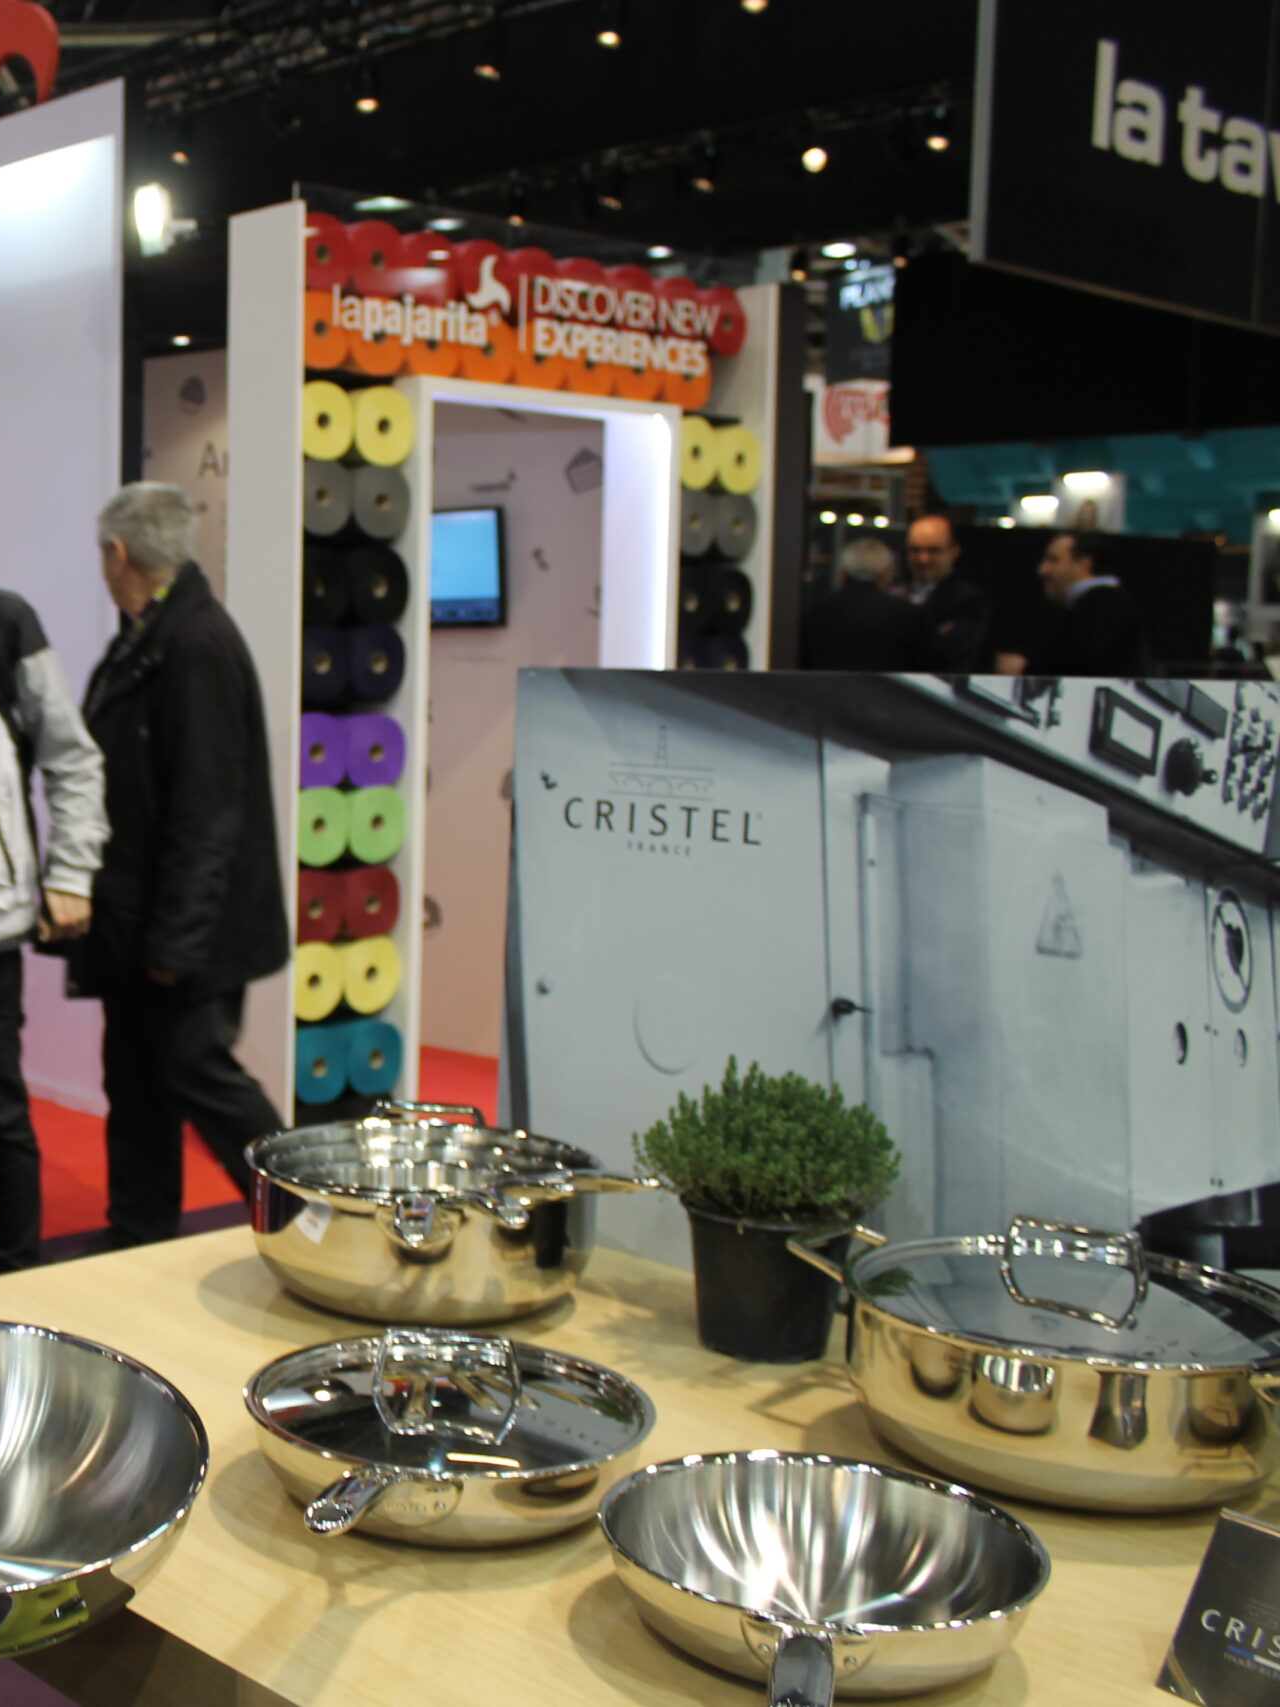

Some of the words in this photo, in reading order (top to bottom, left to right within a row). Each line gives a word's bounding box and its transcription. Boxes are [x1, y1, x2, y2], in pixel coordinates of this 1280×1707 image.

[1091, 38, 1167, 167] la
[331, 283, 489, 346] lapajarita
[533, 276, 657, 330] DISCOVER
[658, 298, 721, 338] NEW
[534, 317, 708, 376] EXPERIENCES
[563, 797, 762, 845] CRISTEL
[1200, 1607, 1280, 1659] CRIS
